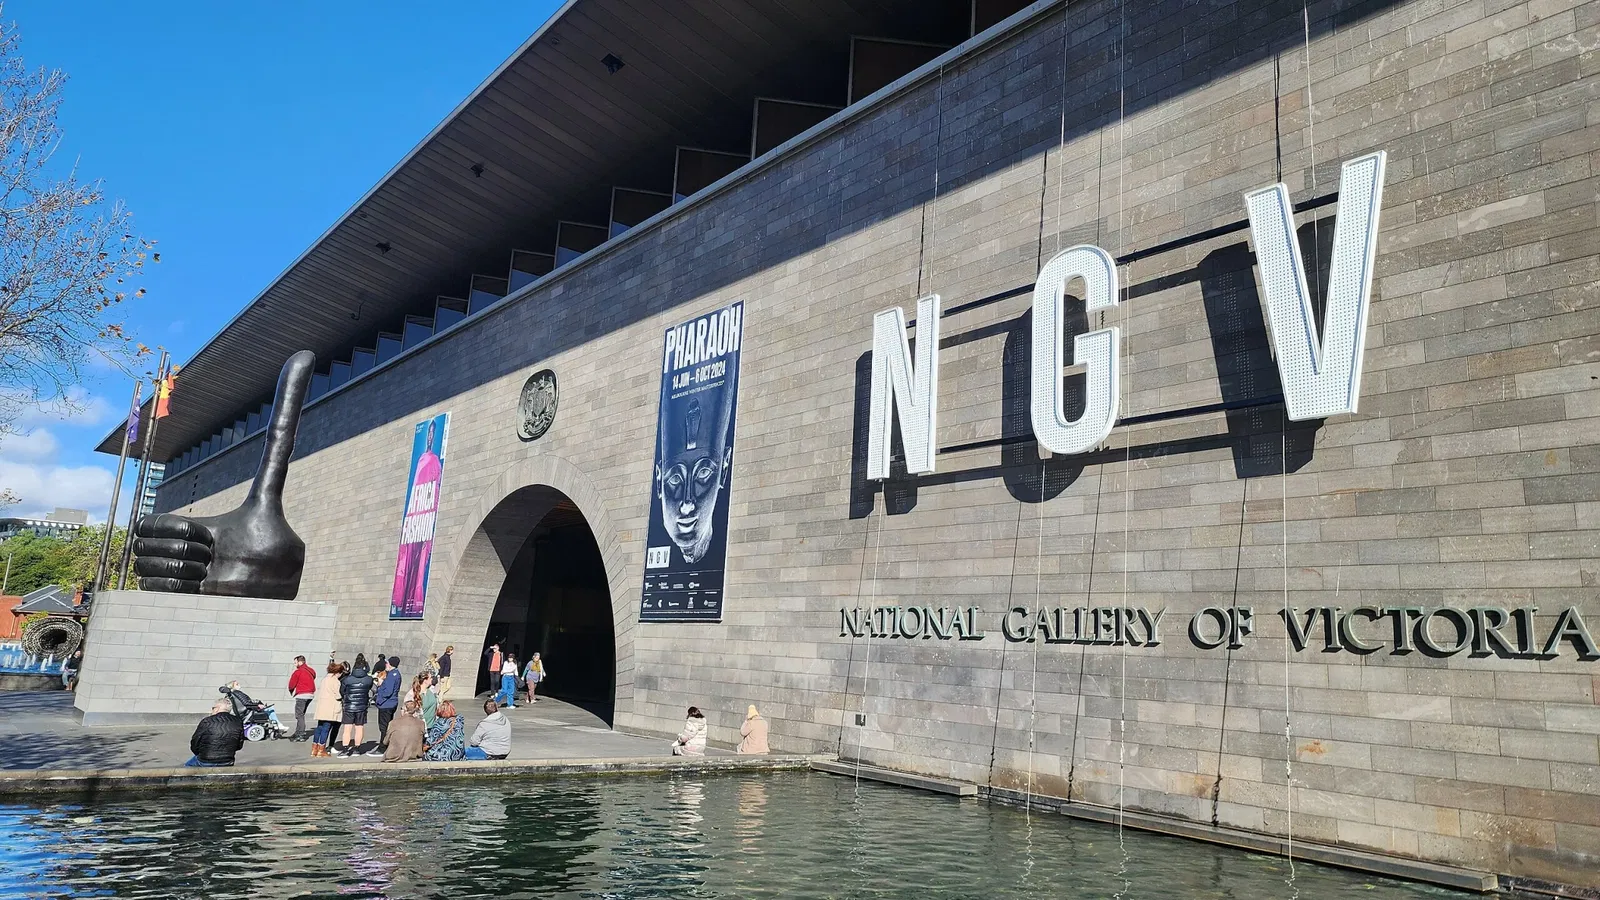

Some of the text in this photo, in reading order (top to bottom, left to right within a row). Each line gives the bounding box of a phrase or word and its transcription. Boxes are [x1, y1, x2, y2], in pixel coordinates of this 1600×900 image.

[663, 305, 742, 374] PHARAOH
[672, 374, 679, 390] 14
[700, 364, 712, 382] OCT
[711, 359, 726, 379] 2024
[407, 481, 437, 514] AFRICA
[401, 511, 436, 545] FASHION
[839, 604, 1600, 661] NATIONAL GALLERY OF VICTORIA
